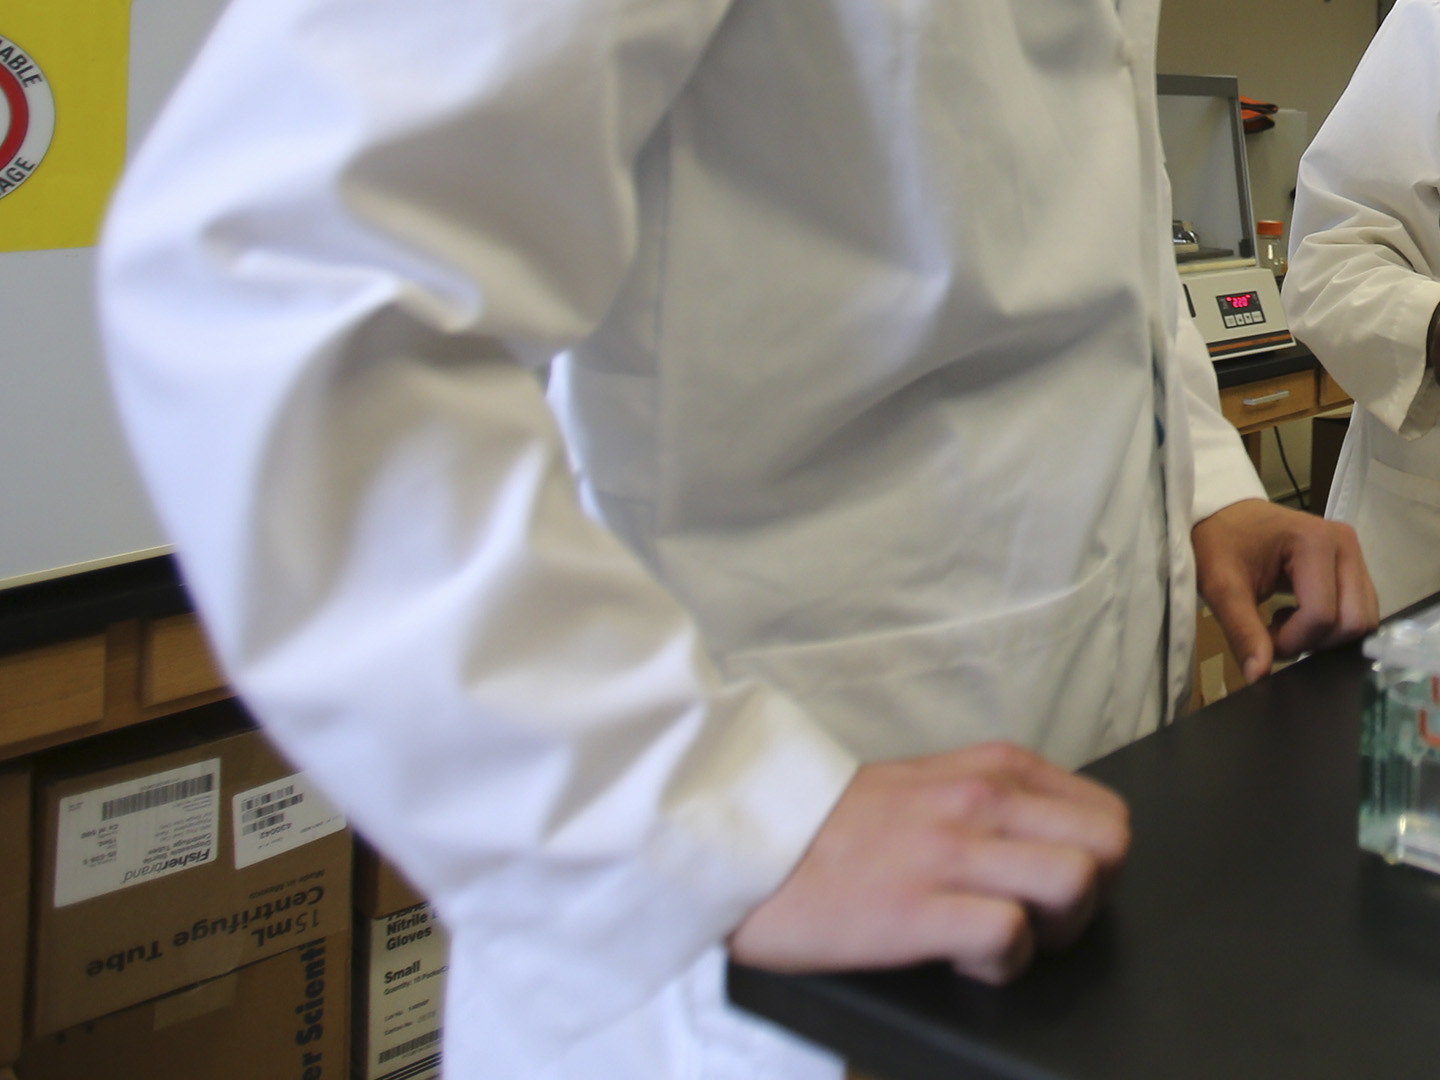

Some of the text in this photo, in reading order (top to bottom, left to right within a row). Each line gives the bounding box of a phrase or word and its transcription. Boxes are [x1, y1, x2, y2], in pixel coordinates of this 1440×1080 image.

[0, 41, 43, 88] ABLE
[0, 157, 36, 196] AGE
[121, 848, 211, 884] Fisherbrand
[86, 885, 325, 977] Centrifuge Tube
[386, 913, 428, 937] Nitrile
[386, 926, 432, 951] Gloves
[384, 960, 420, 985] Small
